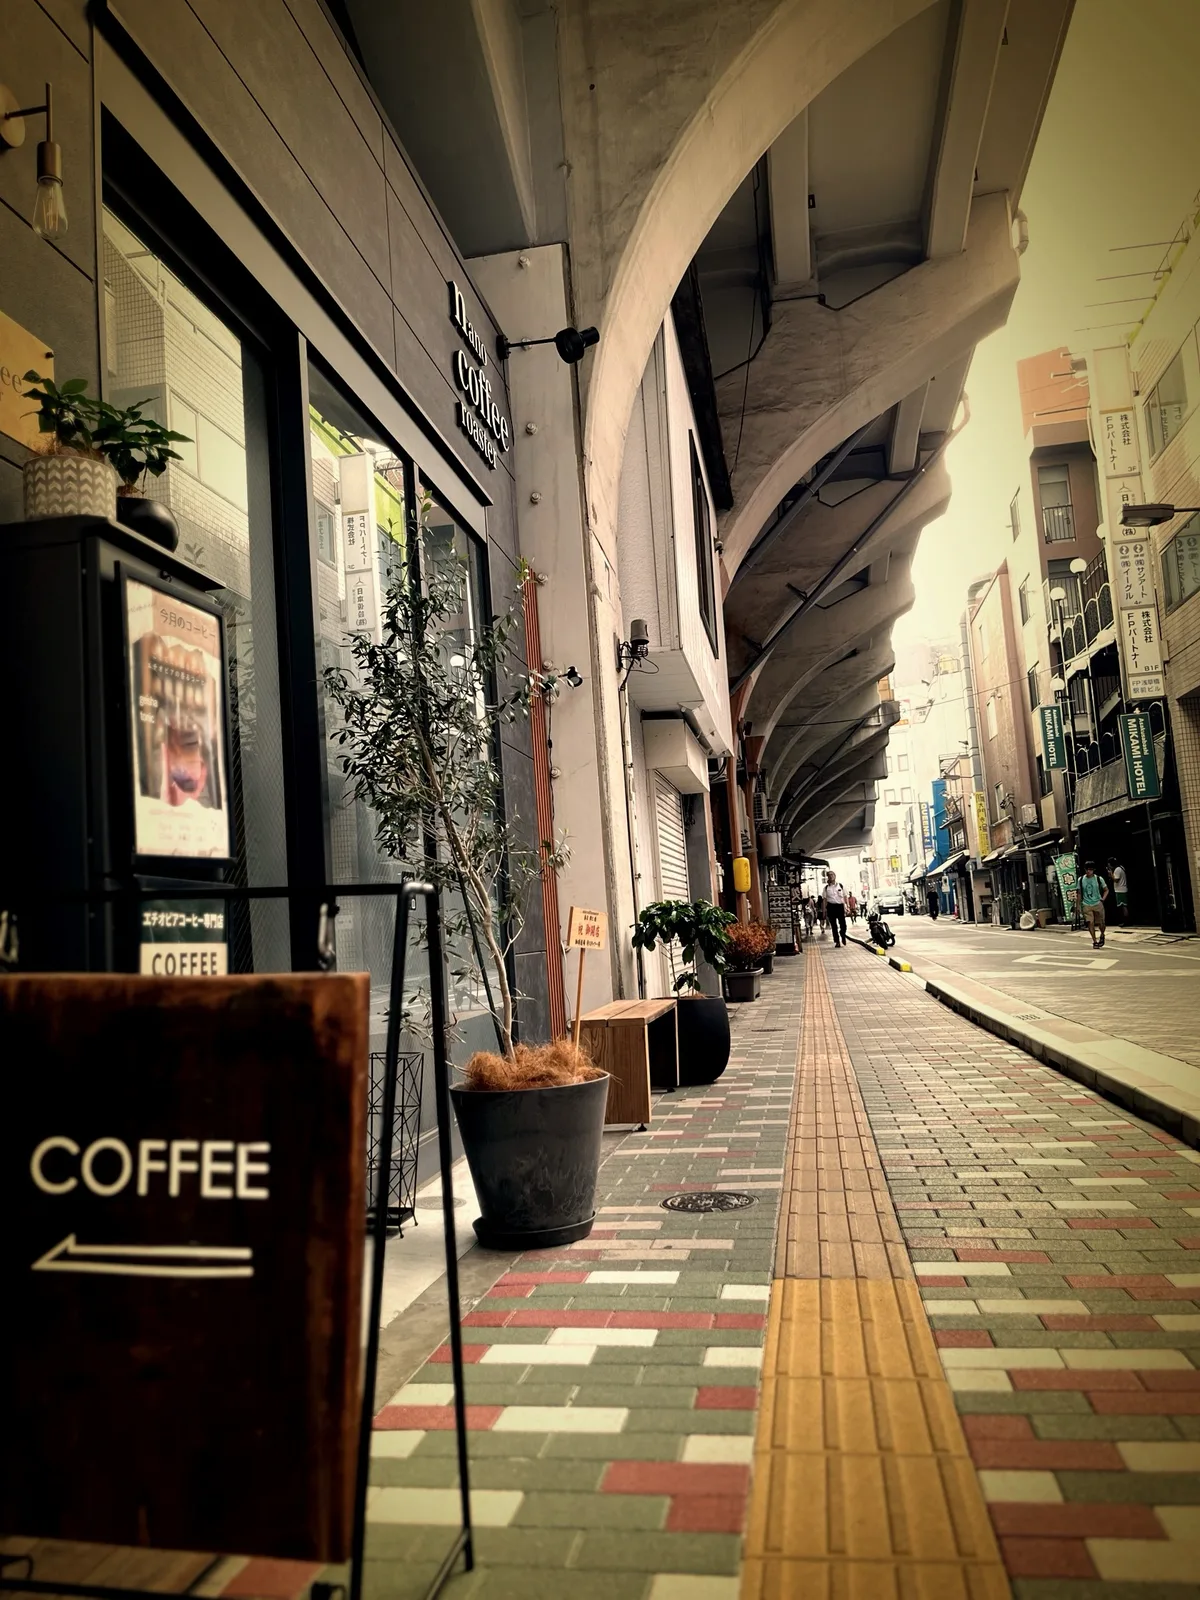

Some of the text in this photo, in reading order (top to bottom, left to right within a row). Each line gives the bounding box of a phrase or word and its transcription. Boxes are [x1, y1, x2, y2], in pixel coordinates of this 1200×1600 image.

[461, 402, 498, 470] roaster
[1120, 414, 1132, 446] 株式会社
[160, 608, 216, 638] 今月のコーヒー
[1141, 611, 1153, 643] 株式会社
[1044, 709, 1057, 767] MIKAMI HOTEL
[1127, 718, 1146, 795] MIKAMI HOTEL
[142, 912, 224, 929] エチオピアコーヒー専門店
[151, 952, 218, 976] COFFEE
[30, 1136, 271, 1199] COFFEE
